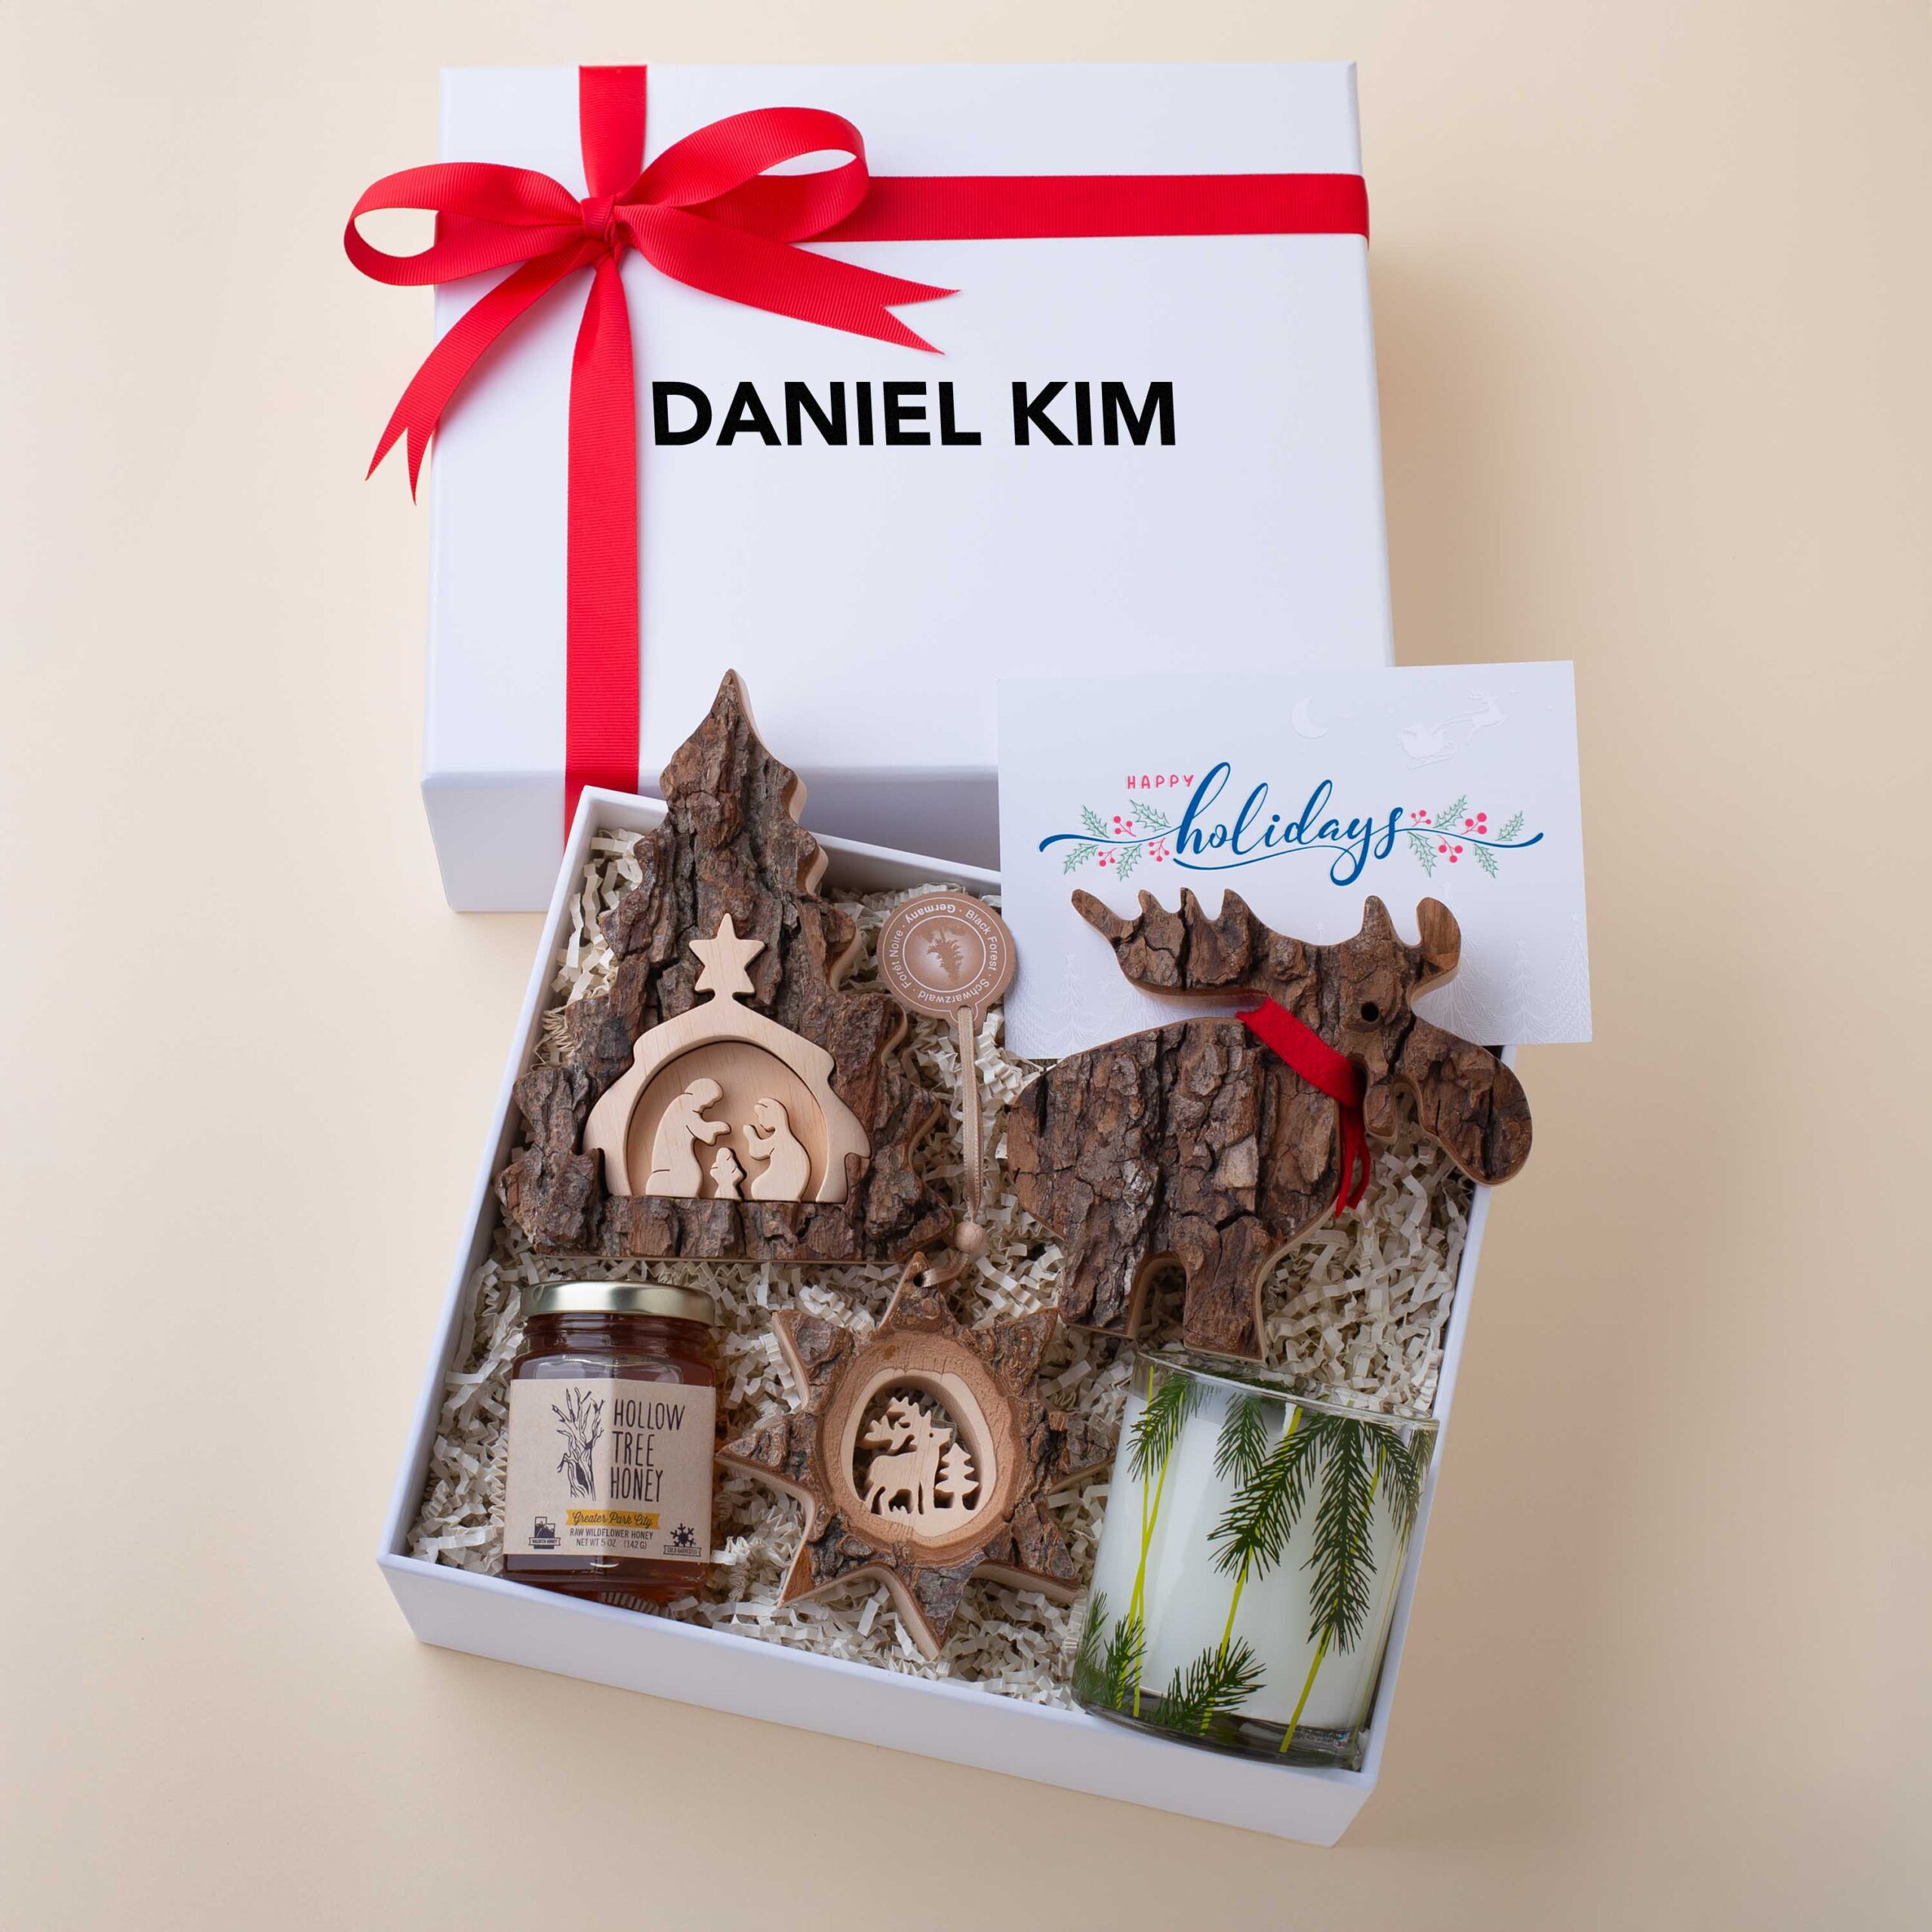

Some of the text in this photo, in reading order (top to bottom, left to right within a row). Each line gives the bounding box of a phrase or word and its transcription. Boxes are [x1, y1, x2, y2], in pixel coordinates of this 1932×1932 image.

[651, 381, 1177, 446] DANIEL KIM
[1127, 774, 1195, 790] HAPPY
[1174, 761, 1404, 887] holidays
[905, 903, 955, 924] Germany
[965, 909, 998, 971] Black Forest
[889, 929, 912, 989] Forêt Noire
[918, 978, 990, 1004] Schwarzwald
[614, 1398, 686, 1431] HOLLOW
[612, 1431, 655, 1467] TREE
[611, 1467, 663, 1503] HONEY
[570, 1527, 654, 1540] RAW WILDFLOWER HONEY
[572, 1510, 654, 1527] Greater Park City
[576, 1537, 648, 1549] NET WT 5 OZ (142 G)
